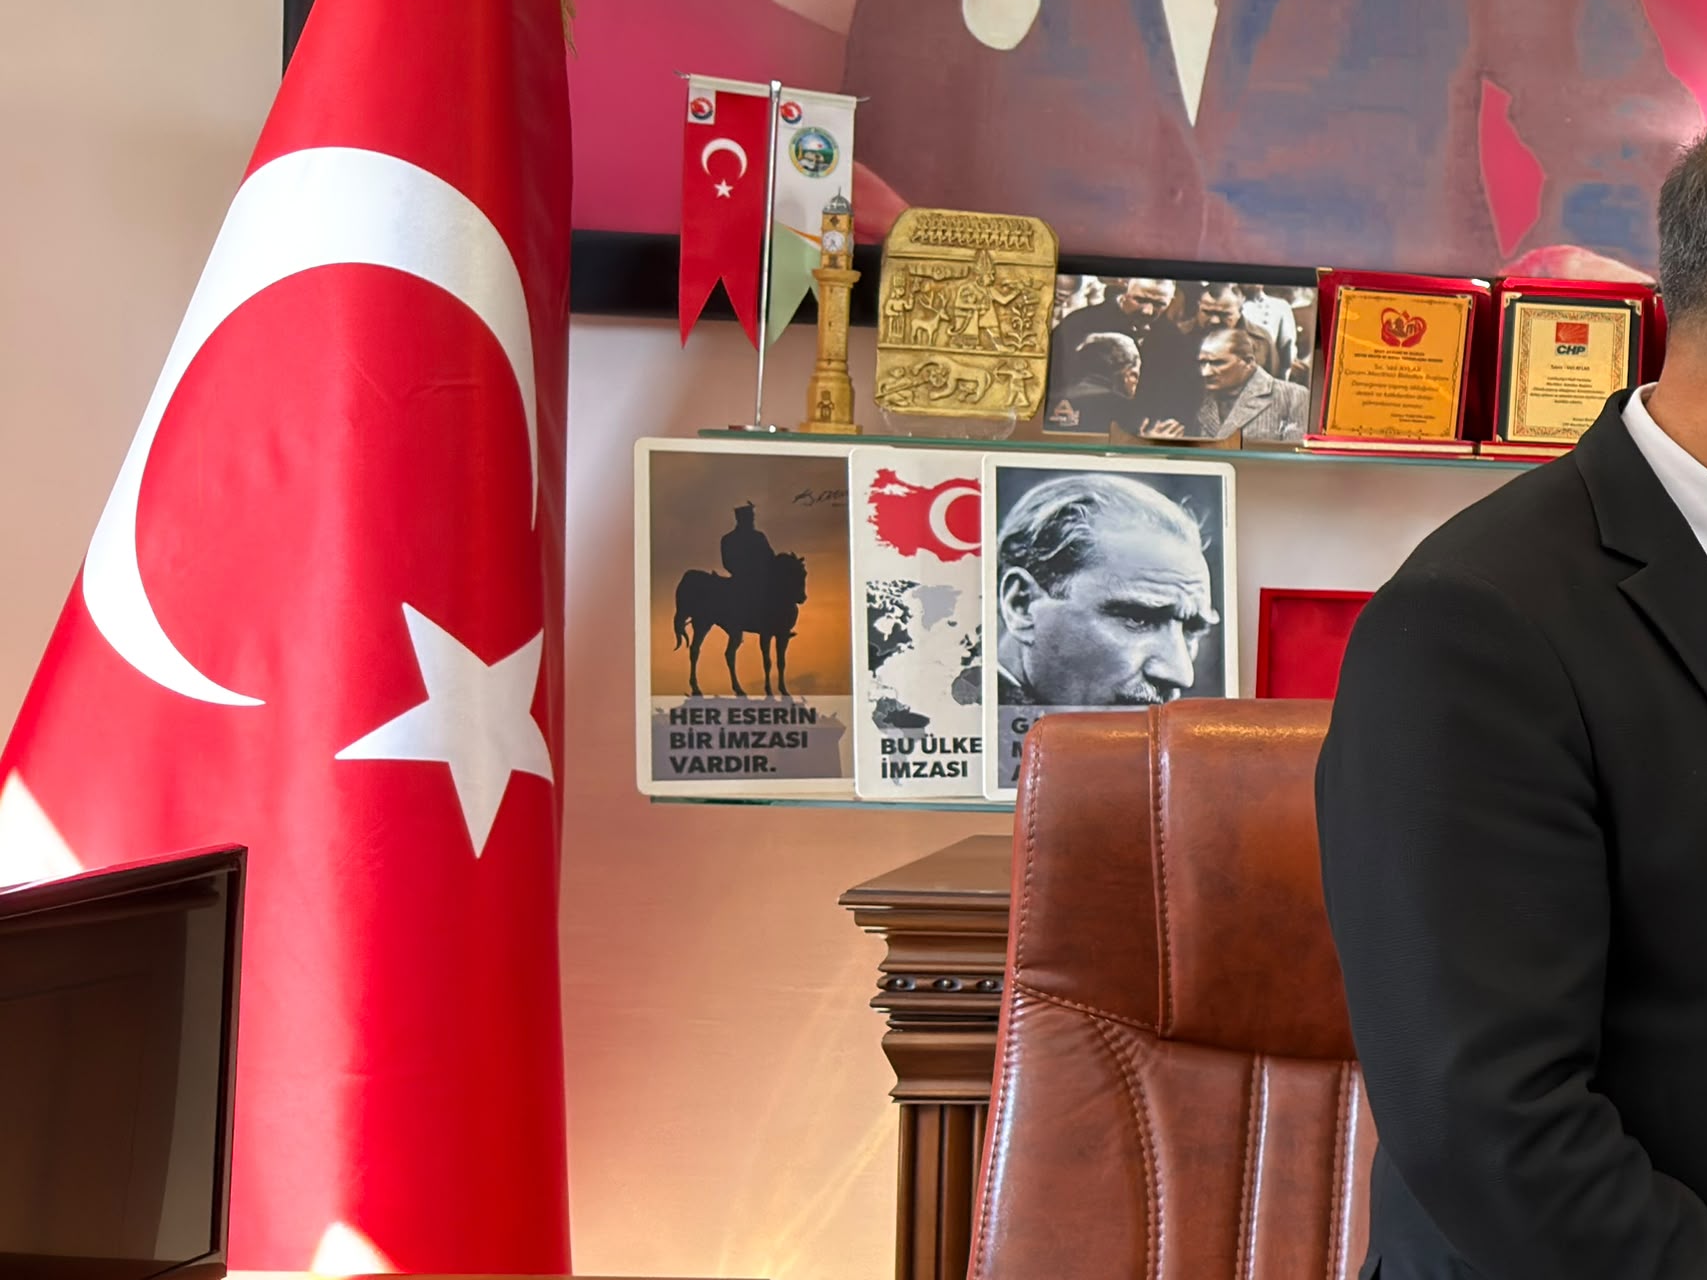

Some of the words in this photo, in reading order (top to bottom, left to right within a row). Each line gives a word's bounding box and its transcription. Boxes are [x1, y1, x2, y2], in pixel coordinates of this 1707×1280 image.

[1556, 345, 1586, 355] CHP
[669, 708, 721, 726] HER
[728, 705, 818, 725] ESERİN
[669, 728, 713, 749] BİR
[719, 727, 809, 749] İMZASI
[880, 738, 915, 755] BU
[920, 732, 982, 755] ÜLKE
[669, 755, 777, 774] VARDIR.
[880, 757, 967, 779] İMZASI
